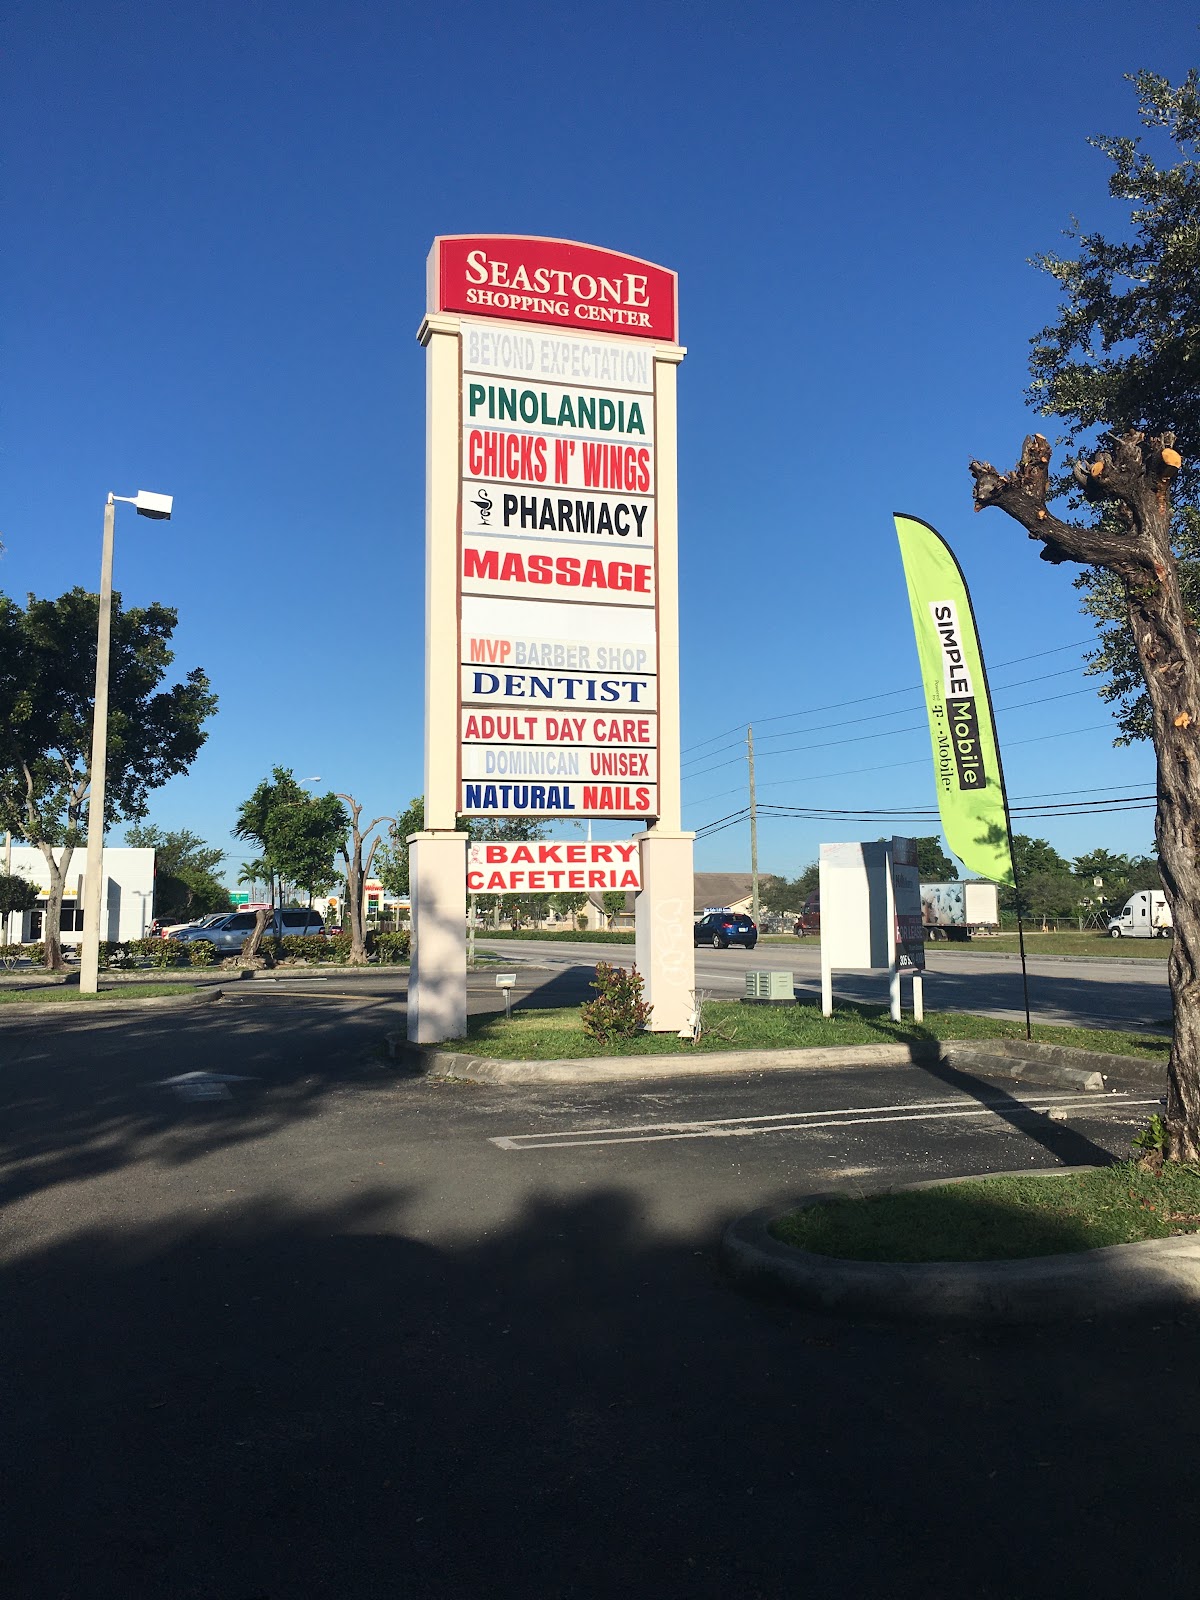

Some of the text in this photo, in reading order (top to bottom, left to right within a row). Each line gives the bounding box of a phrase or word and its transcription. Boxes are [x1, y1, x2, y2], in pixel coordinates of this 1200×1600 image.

[466, 250, 650, 308] SEASTONE
[466, 288, 653, 328] SHOPPING CENTER
[469, 331, 648, 384] BEYOND EXPECTATION
[469, 384, 646, 435] PINOLANDIA
[469, 430, 547, 482] CHICKS
[583, 442, 650, 492] WINGS
[504, 494, 648, 538] PHARMACY
[464, 548, 652, 594] MASSAGE
[470, 638, 646, 672] MVP BARBER SHOP
[472, 672, 647, 702] DENTIST
[934, 606, 978, 784] SIMPLE Mobile
[466, 715, 650, 742] ADULT DAY CARE
[486, 750, 650, 776] DOMINICAN UNISEX
[466, 784, 650, 810] NATURAL NAILS
[486, 844, 637, 864] BAKERY
[466, 870, 640, 890] CAFETERIA
